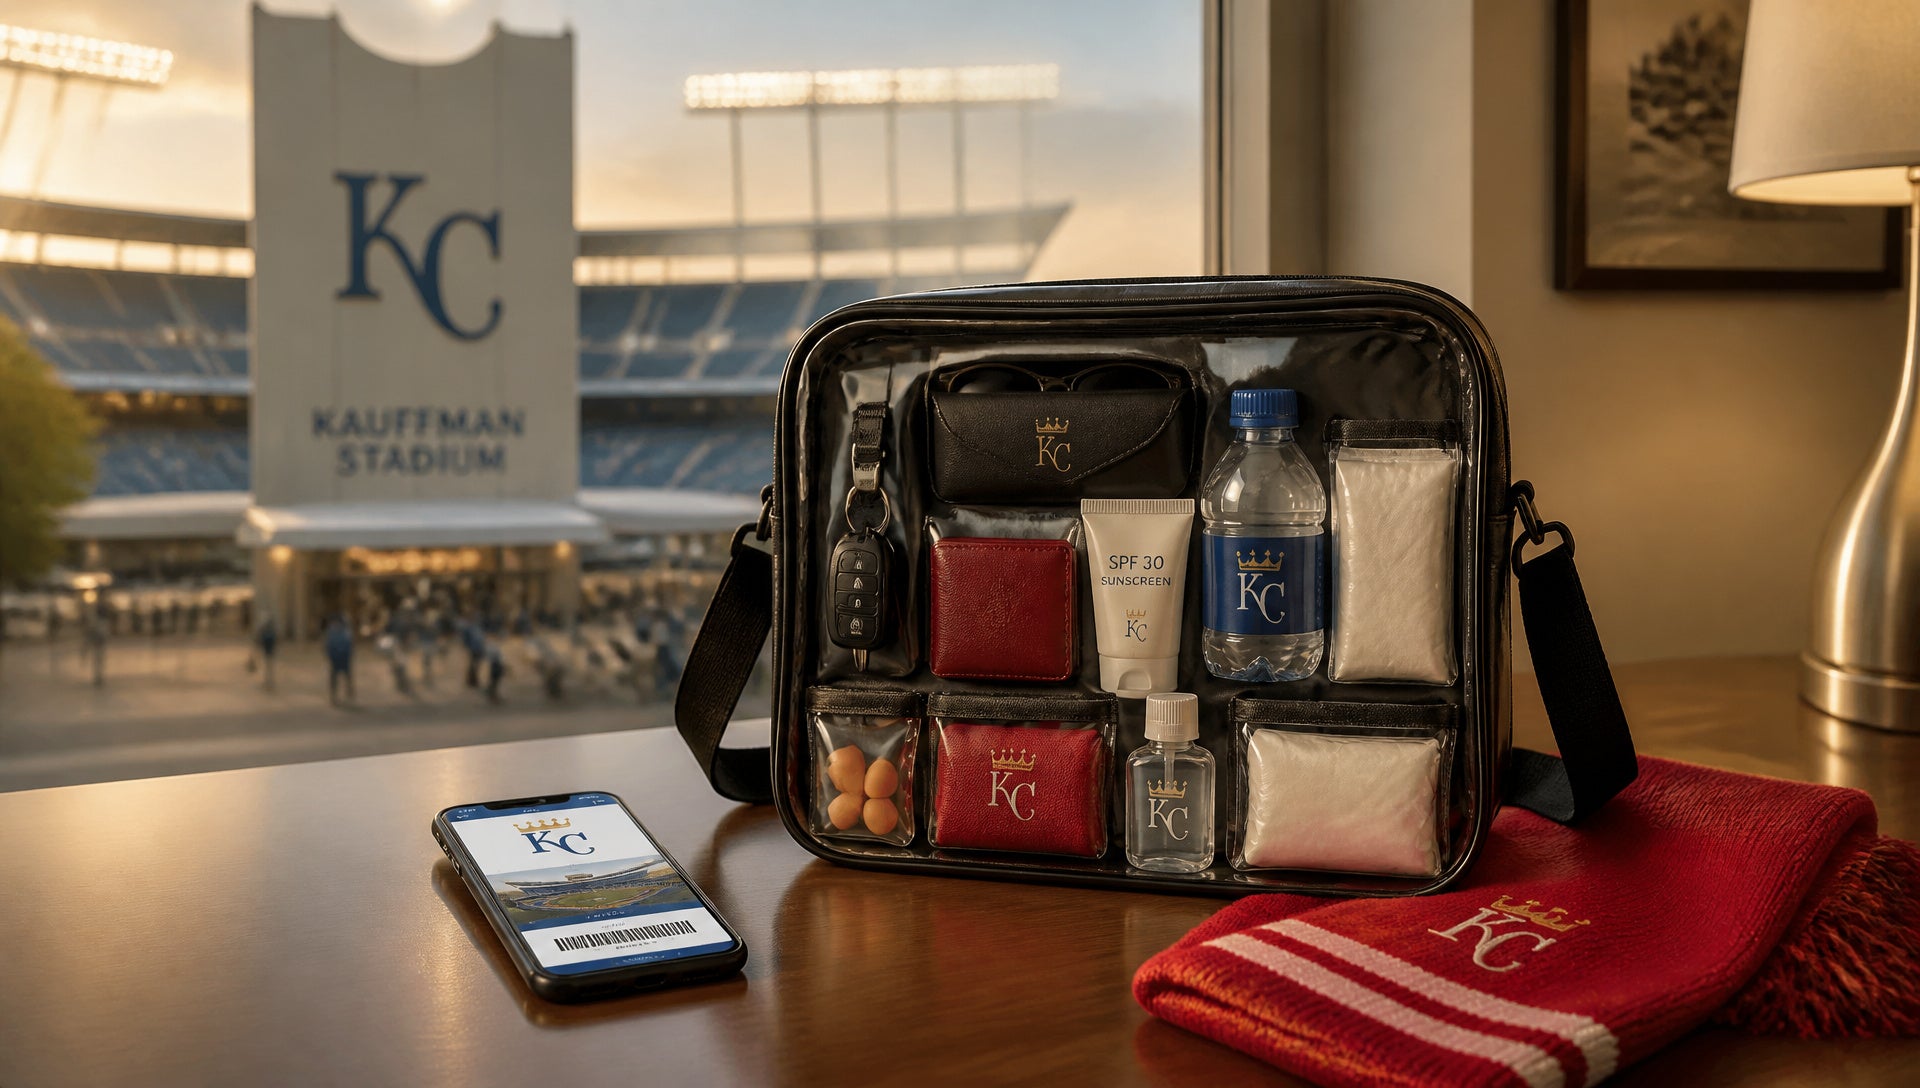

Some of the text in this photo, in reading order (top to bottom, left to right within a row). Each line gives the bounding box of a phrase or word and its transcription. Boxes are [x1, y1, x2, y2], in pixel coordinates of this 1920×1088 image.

[333, 169, 503, 342] KC
[311, 407, 525, 439] KAUFFMAN
[336, 445, 505, 477] STADIUM
[1035, 435, 1071, 473] KC
[1109, 555, 1164, 570] SPF 30
[1101, 576, 1171, 586] SUNSCREEN
[1236, 572, 1285, 624] KC
[1125, 619, 1147, 643] KC
[987, 770, 1036, 821] KC
[1147, 798, 1188, 841] KC
[520, 830, 595, 856] KC
[1427, 907, 1557, 973] KC
